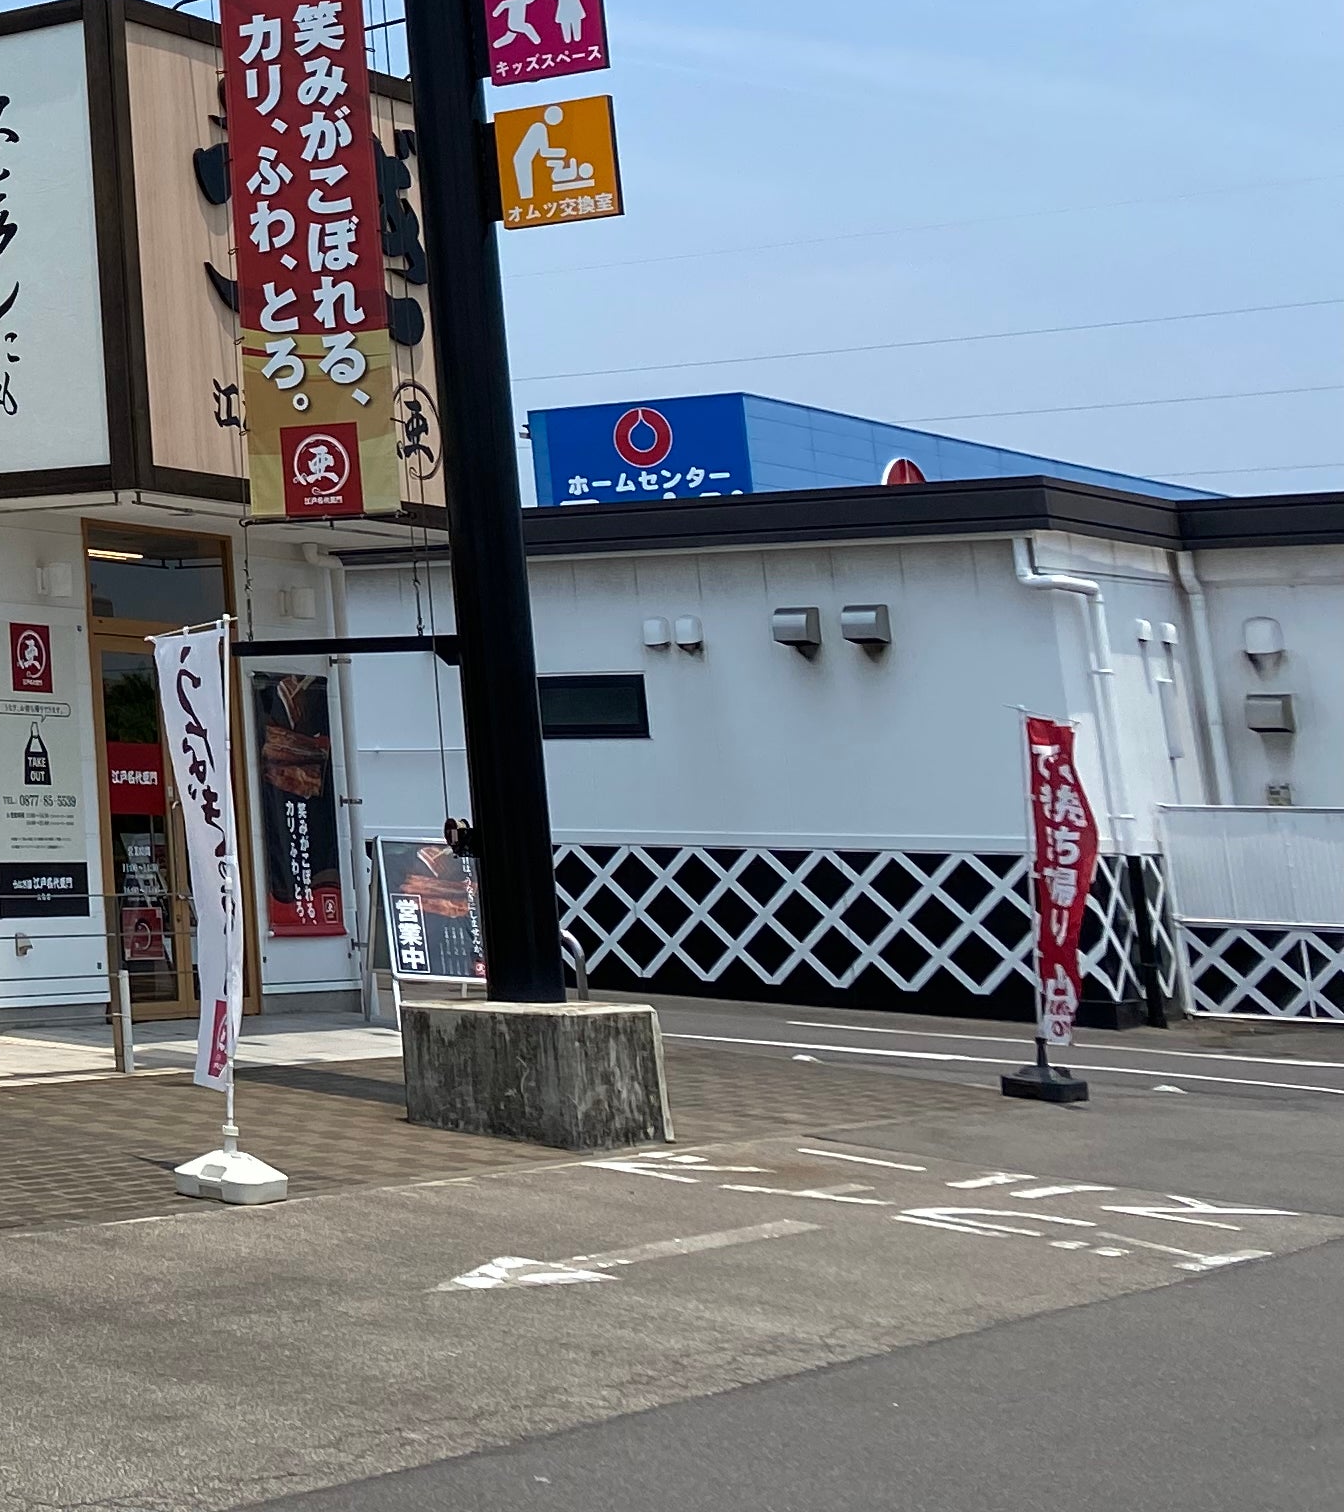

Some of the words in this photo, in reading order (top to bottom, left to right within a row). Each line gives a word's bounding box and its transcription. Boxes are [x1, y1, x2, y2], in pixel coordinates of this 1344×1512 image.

[496, 45, 602, 77] キッズスペース
[238, 13, 310, 412] カリ、ふわ、とろ。
[291, 0, 371, 407] 笑みがこぼれる、
[508, 192, 615, 223] オムツ交換室
[568, 467, 730, 495] ホームセンター
[27, 756, 47, 768] TAKE
[30, 770, 46, 782] OUT
[395, 899, 426, 969] 営業中
